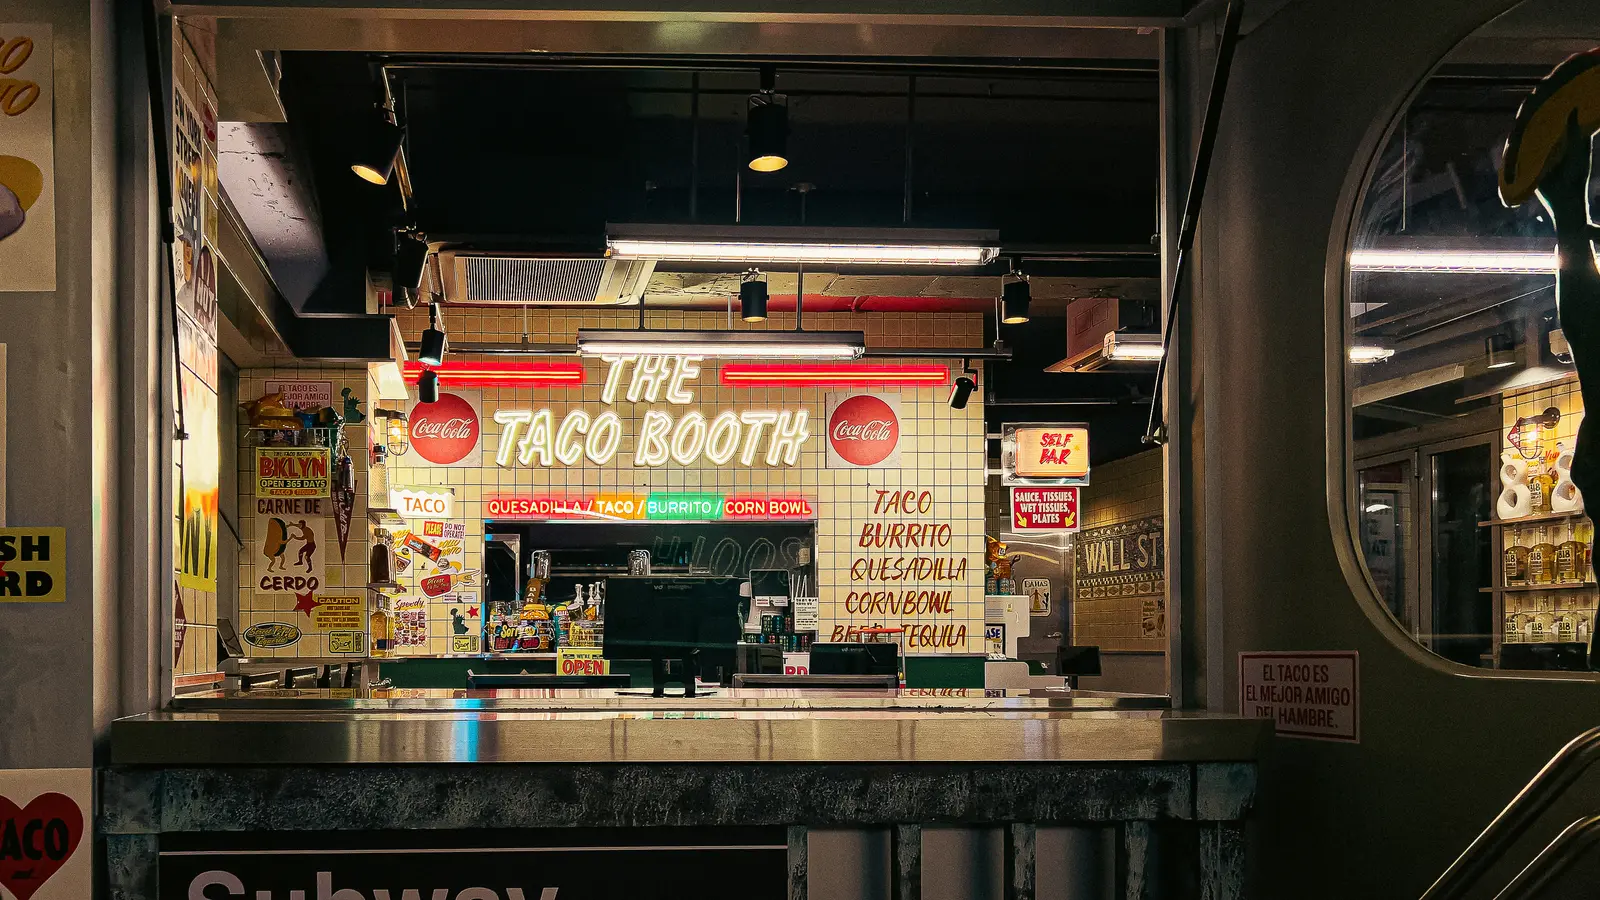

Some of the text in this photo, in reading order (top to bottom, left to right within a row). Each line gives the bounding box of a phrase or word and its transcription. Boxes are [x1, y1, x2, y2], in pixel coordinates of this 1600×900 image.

[601, 354, 704, 405] THE
[411, 417, 474, 440] Coca-Cola
[493, 408, 811, 468] TACO BOOTH
[833, 419, 894, 442] Coca-Cola
[1039, 433, 1074, 448] SELF
[260, 456, 327, 478] BKLYN
[1038, 449, 1071, 465] BAR
[257, 499, 301, 514] CARNE
[304, 499, 321, 514] DE
[403, 497, 446, 514] TACO
[873, 489, 932, 514] TACO
[1015, 491, 1075, 503] SAUCE, TISSUES,
[489, 500, 584, 515] QUESADILLA
[596, 500, 634, 515] TACO
[648, 500, 712, 514] BURRITO
[725, 500, 766, 514] CORN
[769, 500, 812, 515] BOWL
[1020, 503, 1070, 514] WET TISSUES,
[1032, 513, 1060, 524] PLATES
[858, 523, 952, 548] BURRITO
[1084, 532, 1161, 575] WALL ST
[850, 557, 967, 581] QUESADILLA
[260, 576, 320, 591] CERDO
[899, 623, 967, 648] TEQUILA
[1559, 622, 1571, 631] 818
[562, 659, 605, 675] OPEN
[1263, 664, 1329, 683] EL TACO ES
[1246, 685, 1351, 706] EL MEJOR AMIGO
[1278, 706, 1339, 729] HAMBRE.
